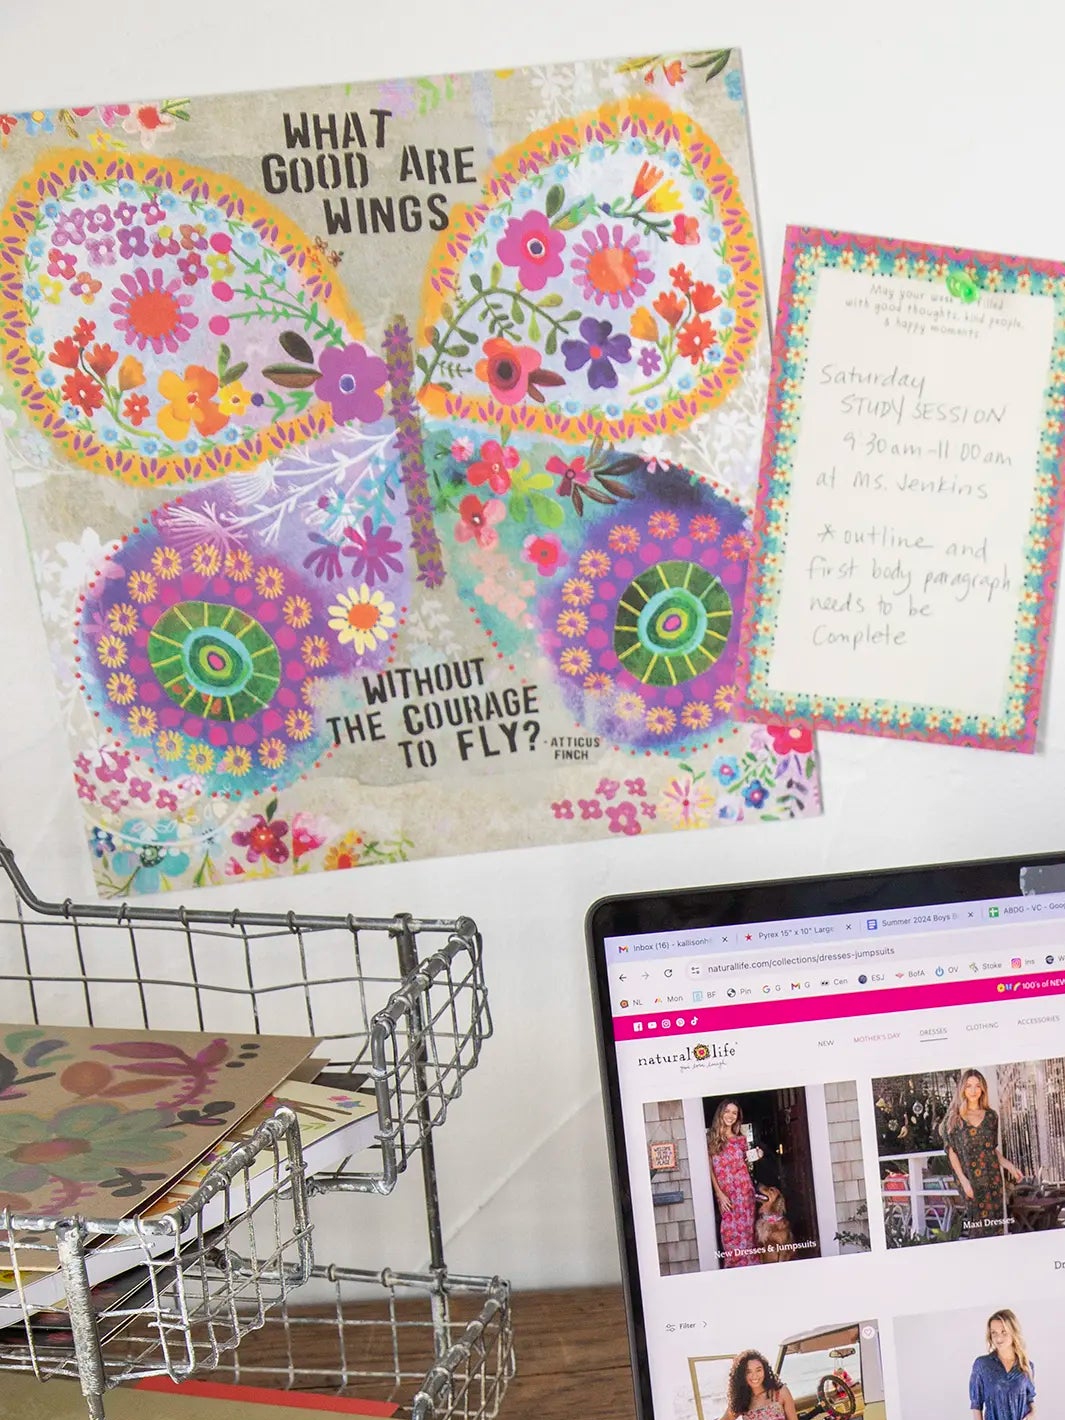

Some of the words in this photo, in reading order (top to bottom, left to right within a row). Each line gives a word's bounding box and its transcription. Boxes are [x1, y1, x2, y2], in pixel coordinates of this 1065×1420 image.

[283, 109, 392, 150] WHAT
[261, 152, 369, 194] GOOD
[399, 145, 477, 185] ARE
[322, 193, 449, 235] WINGS
[870, 284, 895, 298] May
[900, 288, 924, 304] your
[845, 298, 870, 309] with
[875, 301, 901, 314] good
[895, 319, 925, 335] happy
[819, 364, 926, 397] Saturday
[840, 393, 905, 424] STUDY
[912, 400, 1009, 424] SESSION
[816, 466, 836, 489] at
[896, 473, 989, 500] Jenkins
[945, 537, 987, 563] and
[805, 555, 857, 579] first
[872, 557, 911, 596] body
[924, 563, 1010, 602] paragraph
[809, 592, 864, 613] needs
[879, 596, 892, 615] to
[908, 593, 933, 617] be
[362, 658, 484, 705] WITHOUT
[326, 712, 386, 745] THE
[403, 685, 539, 735] COURAGE
[398, 740, 437, 769] TO
[457, 720, 541, 761] FLY?
[550, 737, 600, 748] ATTICUS
[554, 750, 589, 760] FINCH
[1031, 903, 1042, 911] VC
[882, 917, 911, 927] Summer
[913, 914, 931, 923] 2024
[933, 913, 950, 923] Boys
[758, 931, 779, 940] Pyrex
[633, 943, 653, 951] Inbox
[655, 941, 670, 950] (16)
[833, 978, 848, 986] Cen
[871, 974, 885, 982] ESJ
[908, 970, 925, 978] BofA
[633, 998, 643, 1006] NL
[667, 995, 684, 1003] Mon
[966, 1021, 999, 1032] CLOTHING
[1017, 1016, 1060, 1026] ACCESSORIES
[919, 1028, 948, 1037] DRESSES
[638, 1047, 691, 1066] natural
[712, 1043, 735, 1058] life
[963, 1220, 981, 1230] Maxi
[983, 1216, 1015, 1228] Dresses
[715, 1250, 733, 1259] New
[734, 1247, 766, 1257] Dresses
[776, 1240, 817, 1253] Jumpsuits
